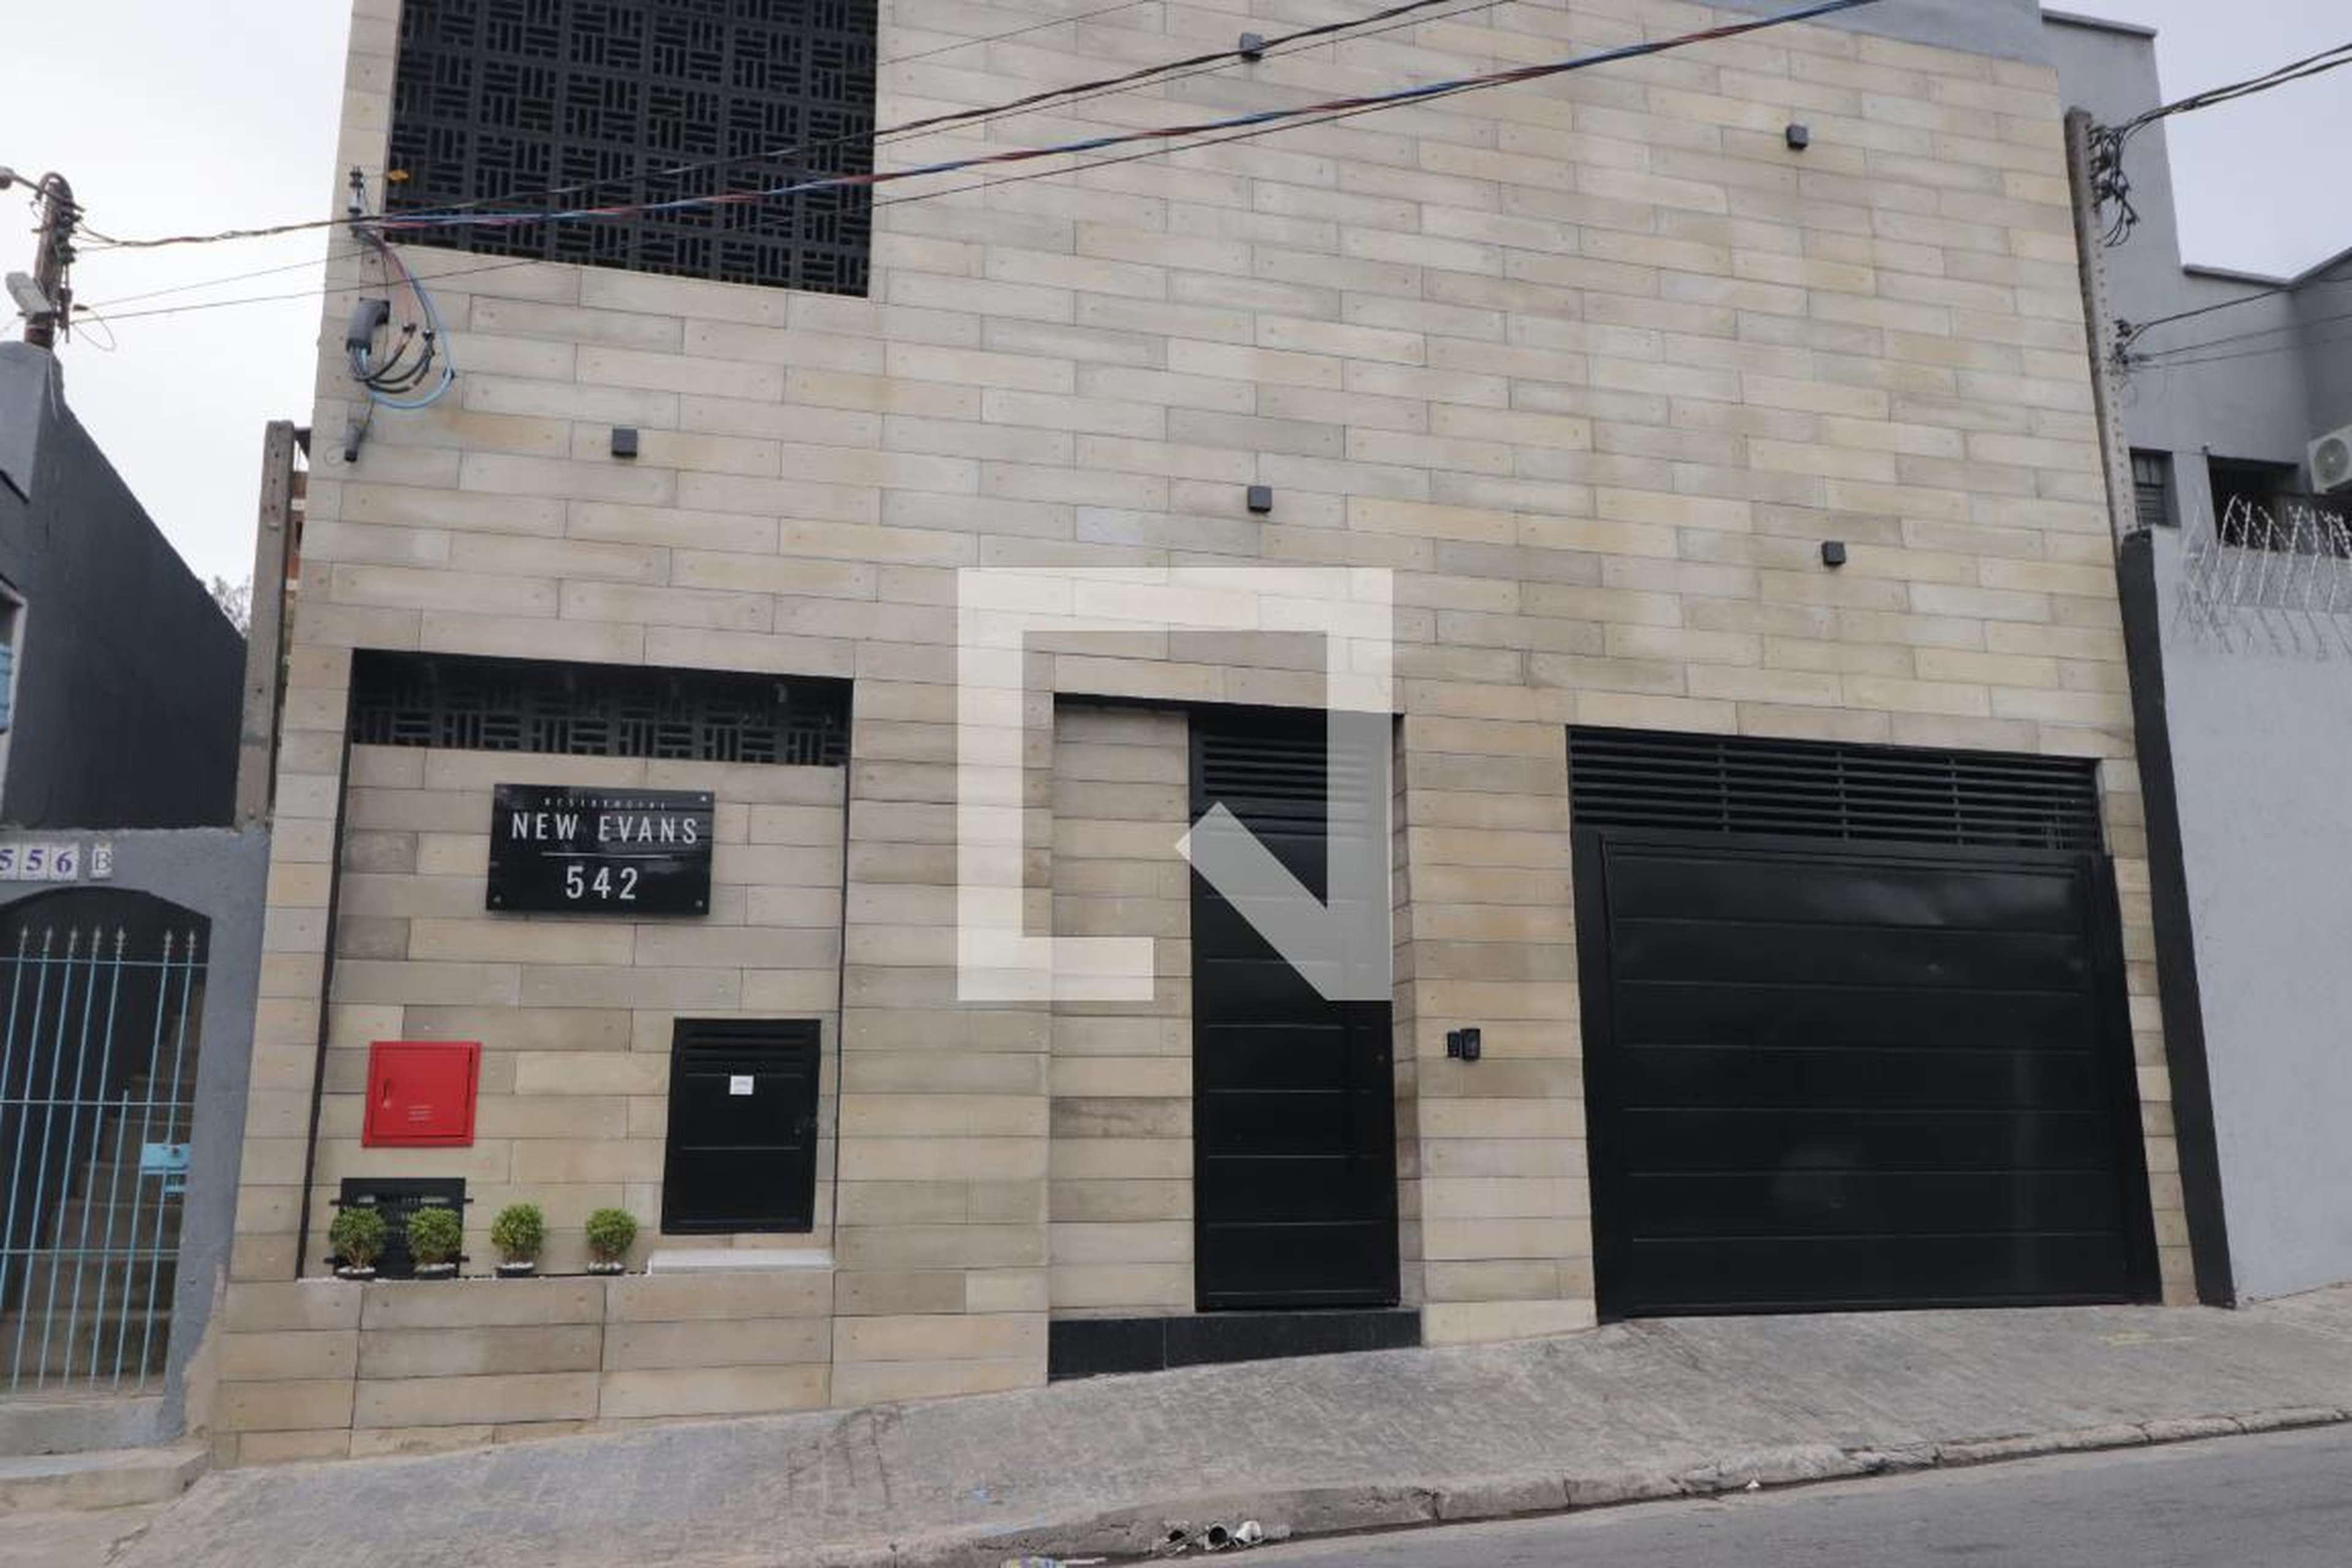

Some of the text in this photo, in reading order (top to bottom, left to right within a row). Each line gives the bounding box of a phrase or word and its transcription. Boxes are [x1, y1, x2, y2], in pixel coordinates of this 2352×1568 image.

[512, 812, 698, 844] NEW EVANS
[565, 865, 638, 899] 542
